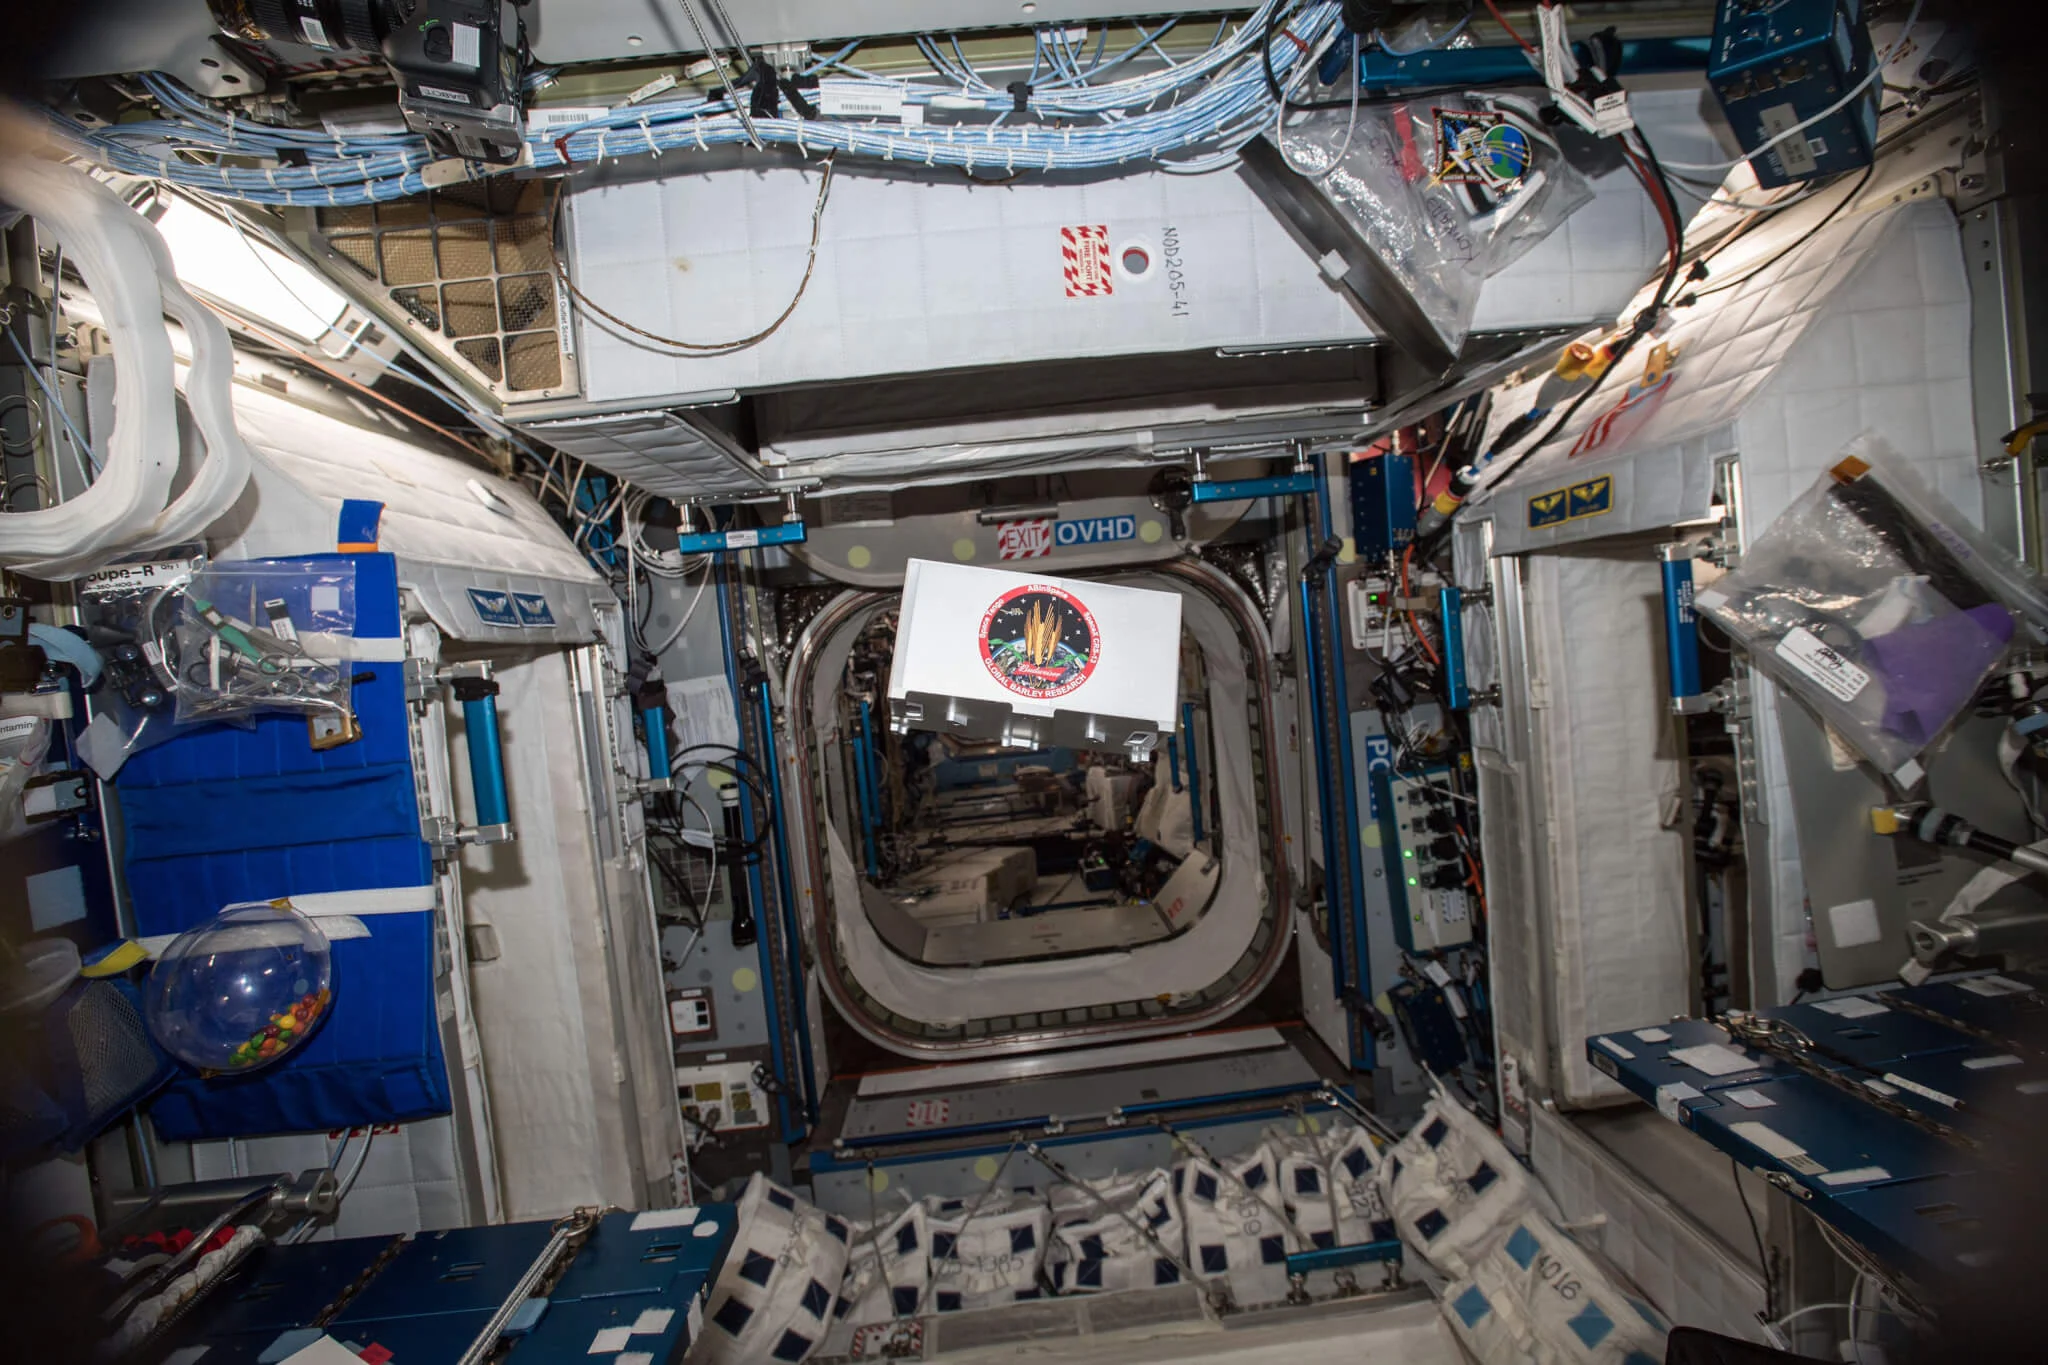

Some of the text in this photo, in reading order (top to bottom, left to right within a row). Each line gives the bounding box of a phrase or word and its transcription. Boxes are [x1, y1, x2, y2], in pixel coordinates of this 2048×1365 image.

[1083, 240, 1093, 281] FIRE PORT
[559, 300, 568, 325] Outlet
[561, 326, 570, 352] Screen
[1005, 526, 1041, 550] EXIT
[1057, 517, 1135, 545] OVHD
[87, 564, 155, 582] oupe-R
[1027, 584, 1068, 599] ABinSpace
[979, 598, 1005, 639] Space Tango
[1083, 611, 1099, 638] SpaceX
[984, 657, 1087, 698] GLOBAL BARLEY RESEARCH
